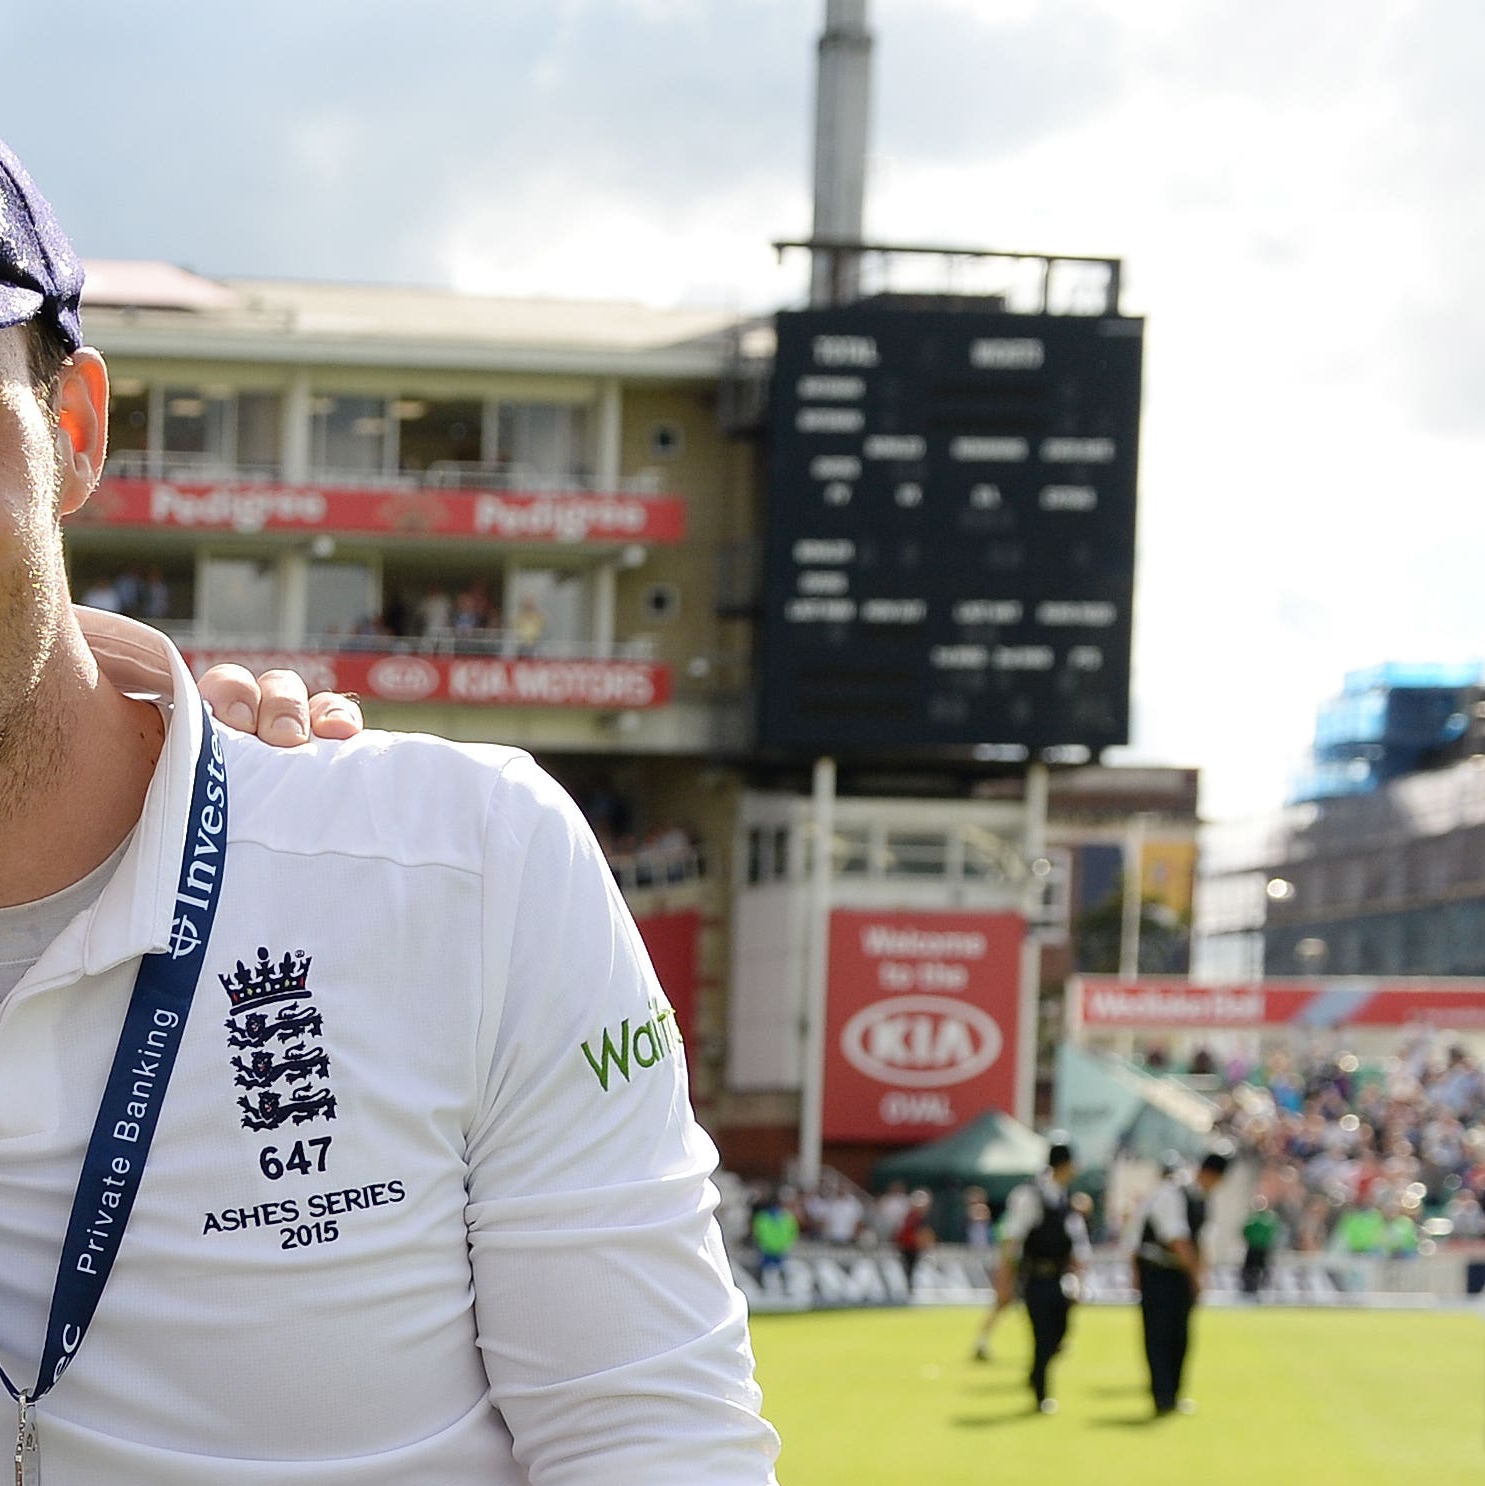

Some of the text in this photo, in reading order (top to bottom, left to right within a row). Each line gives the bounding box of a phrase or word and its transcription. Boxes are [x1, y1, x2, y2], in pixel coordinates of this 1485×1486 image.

[152, 487, 326, 533] Pedigree
[475, 496, 648, 543] Pedigree
[177, 728, 225, 912] Investe
[879, 1090, 955, 1126] OVAL
[76, 1008, 179, 1276] Private Banking
[260, 1136, 332, 1180] 647
[203, 1180, 406, 1235] ASHES SERIES
[280, 1220, 339, 1249] 2015
